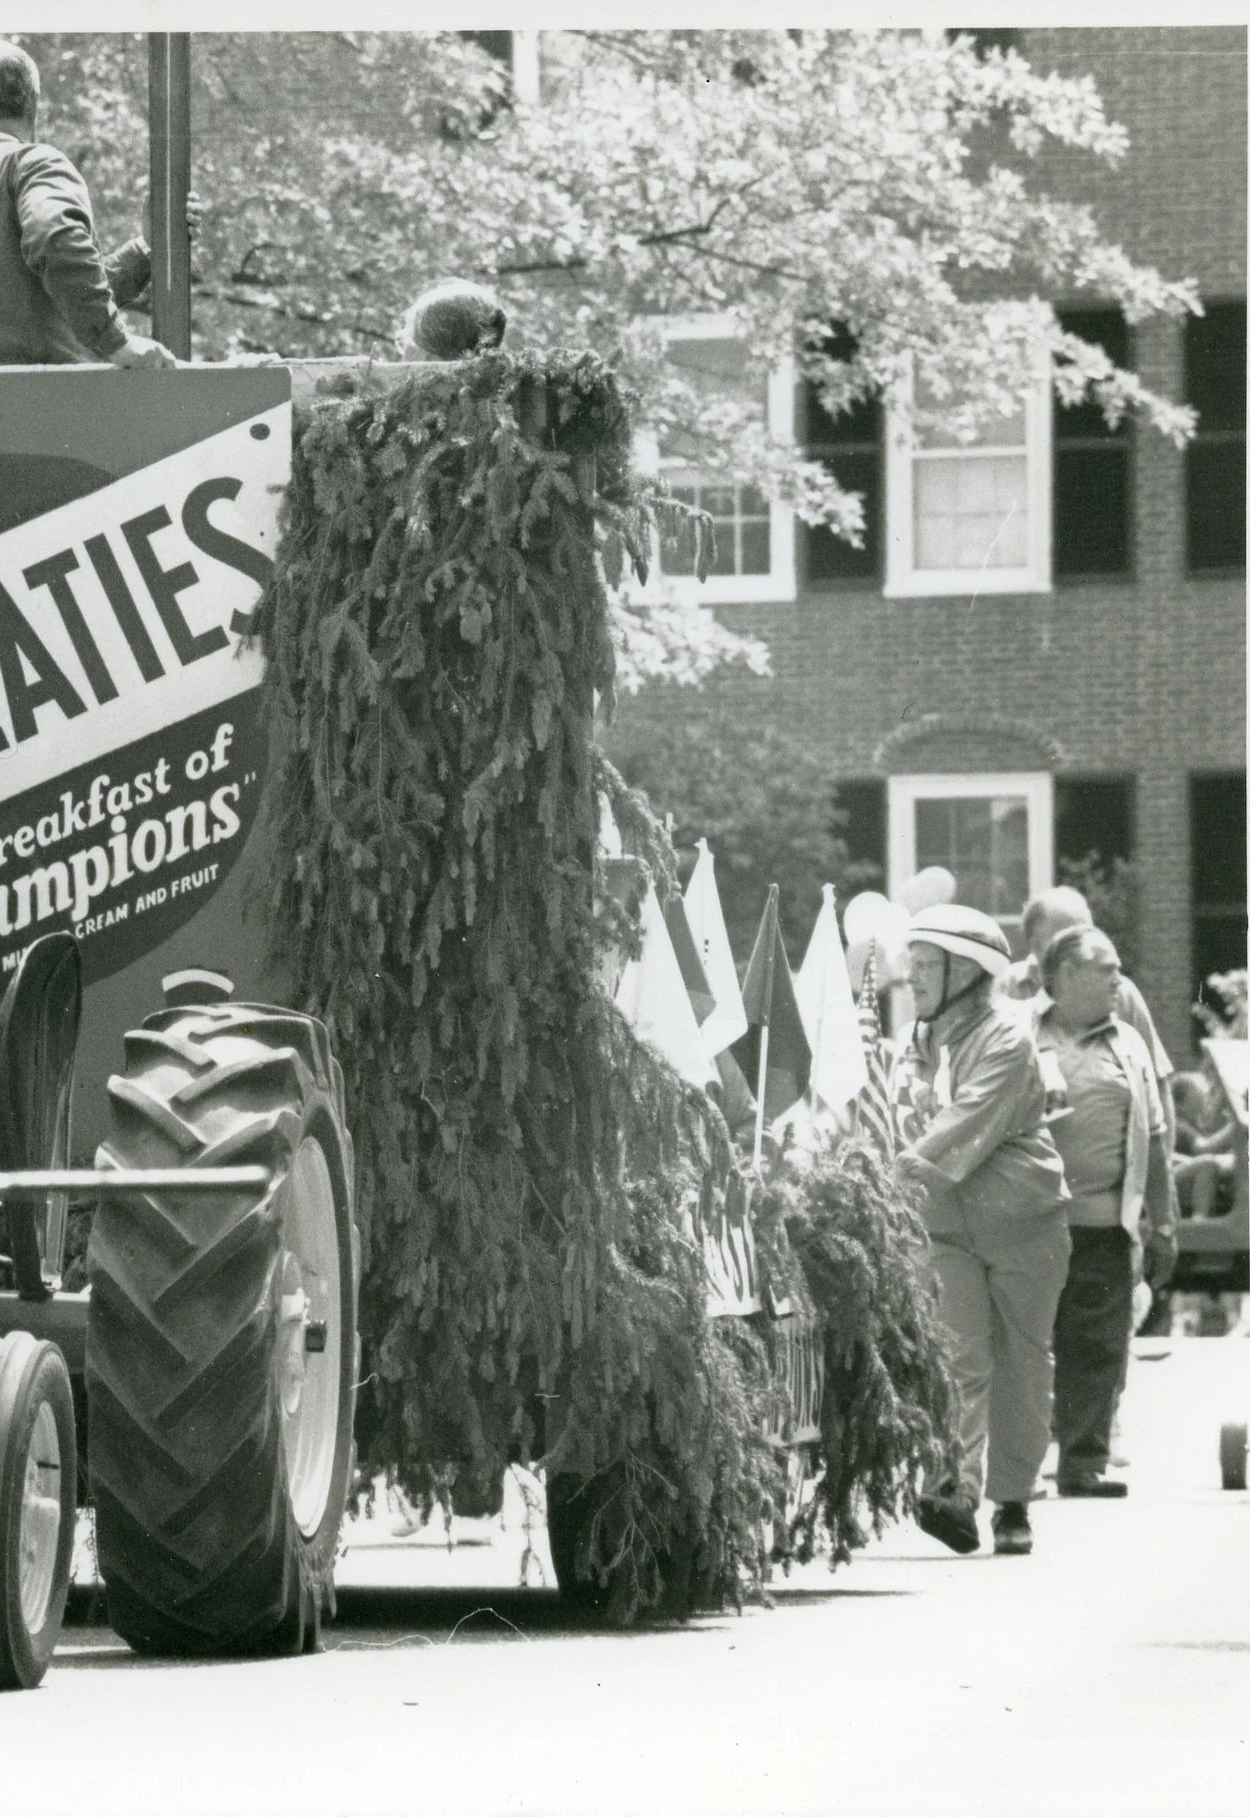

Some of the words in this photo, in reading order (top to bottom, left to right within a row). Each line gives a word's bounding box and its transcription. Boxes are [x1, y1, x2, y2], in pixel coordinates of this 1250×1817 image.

[185, 723, 234, 780] of
[74, 903, 129, 939] CREAM
[135, 887, 167, 914] AND
[171, 863, 220, 898] FRUIT
